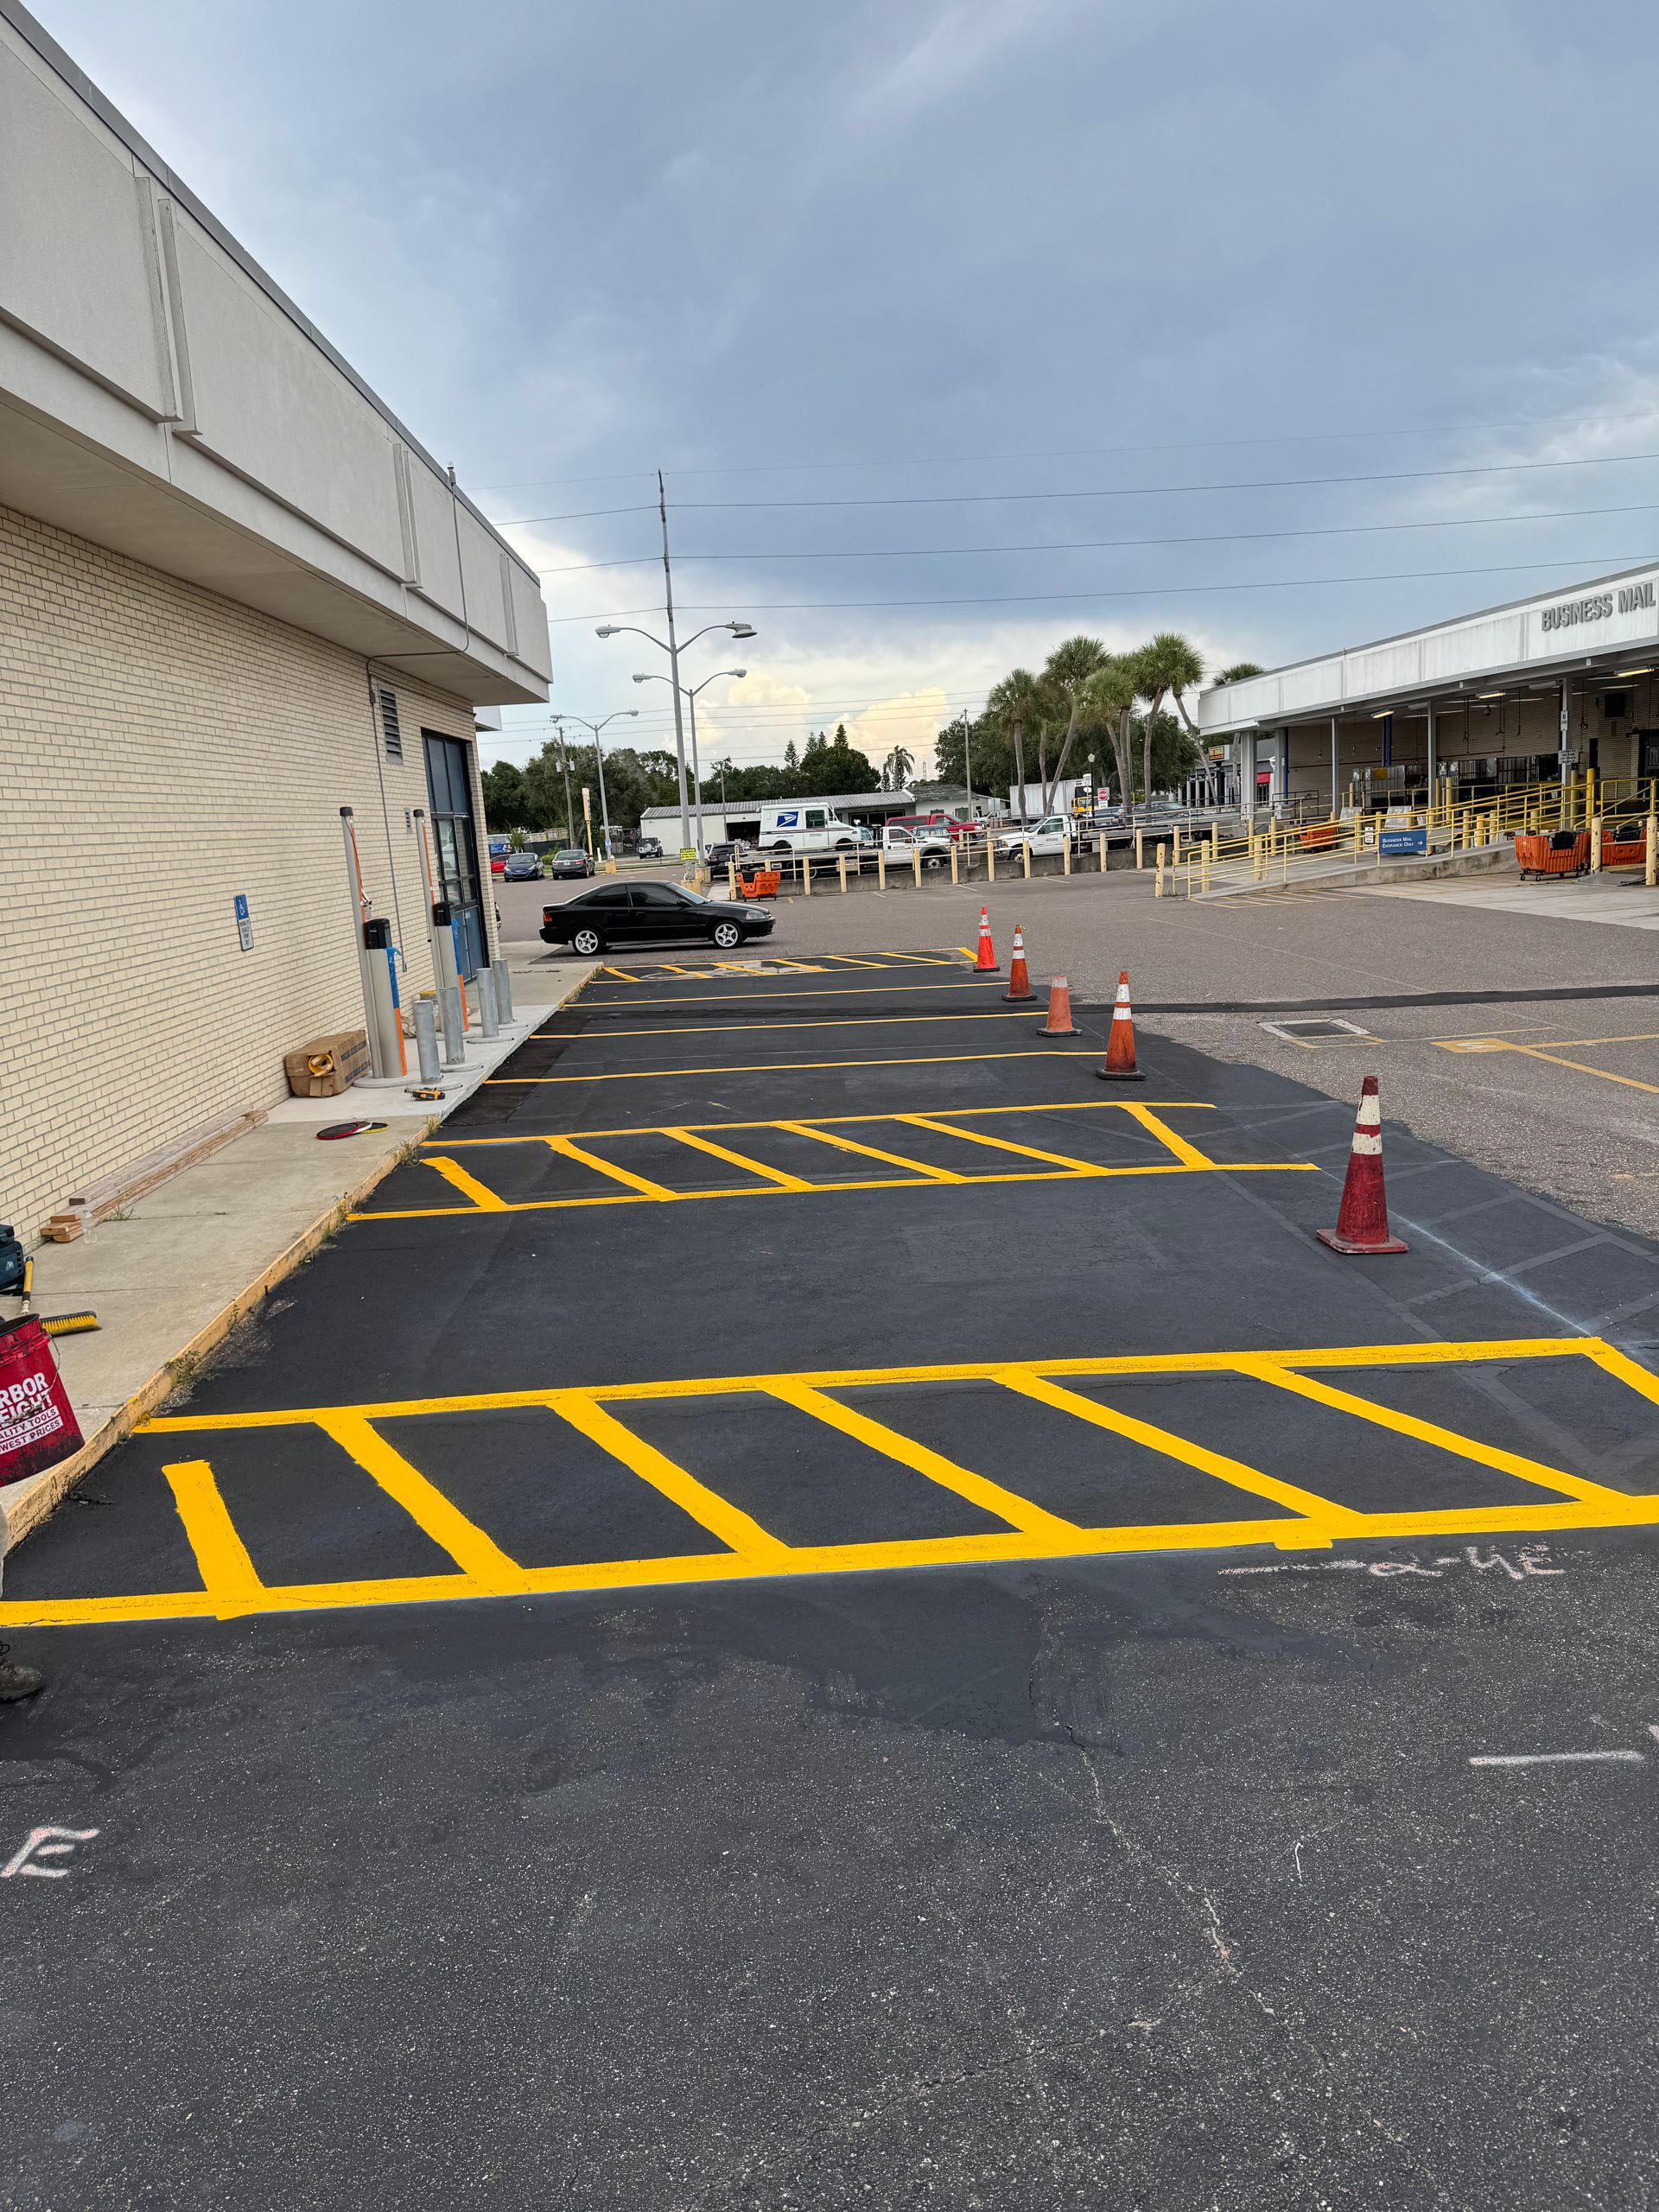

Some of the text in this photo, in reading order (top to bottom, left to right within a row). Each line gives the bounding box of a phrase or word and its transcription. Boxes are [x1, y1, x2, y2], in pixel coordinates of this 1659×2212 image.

[1541, 582, 1656, 632] BUSINESS MAIL
[28, 1408, 56, 1427] TOOLS
[29, 1420, 60, 1440] PRICES
